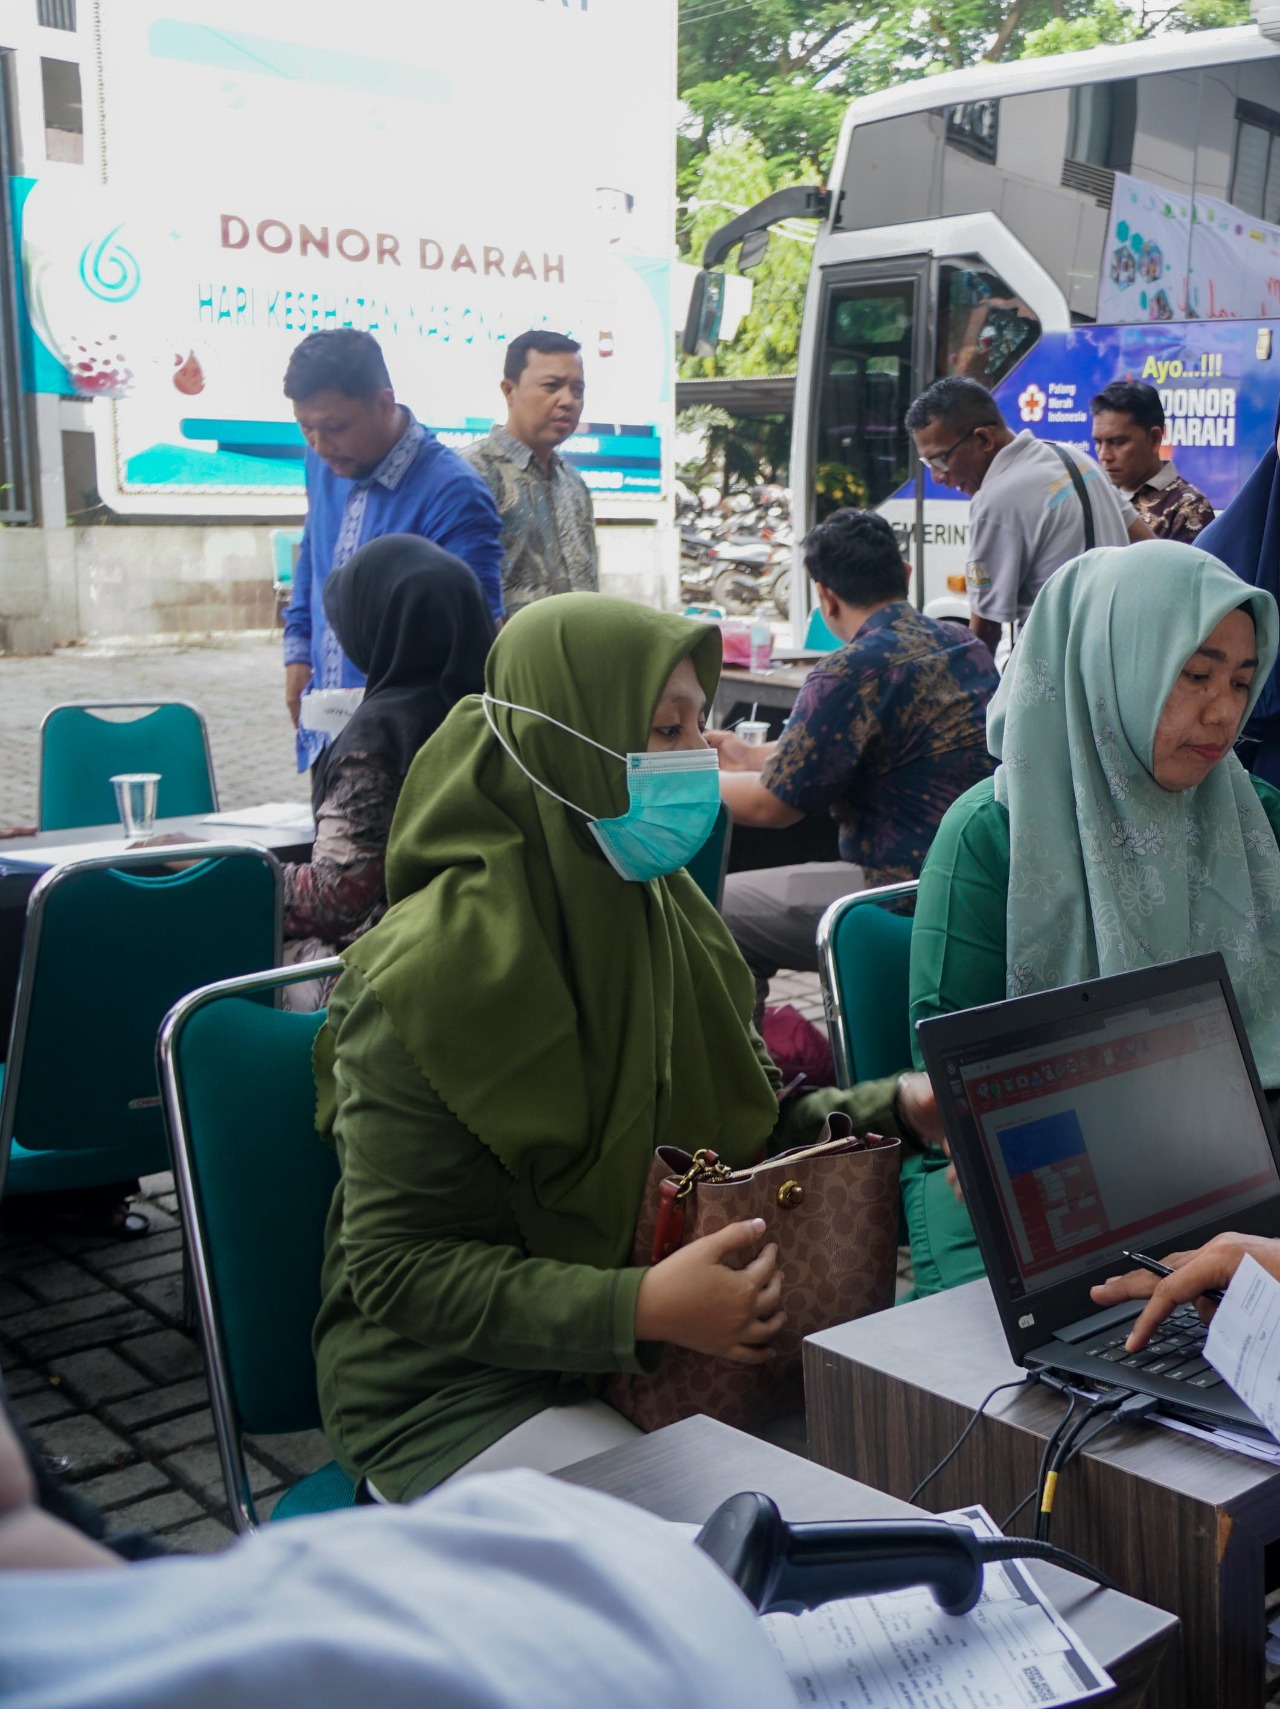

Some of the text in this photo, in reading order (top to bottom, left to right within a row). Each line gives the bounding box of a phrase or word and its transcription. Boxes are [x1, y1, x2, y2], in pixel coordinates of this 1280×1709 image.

[220, 213, 566, 284] DONOR DARAH
[198, 283, 256, 326] HARI
[1048, 383, 1077, 396] Palang
[1160, 387, 1236, 418] DONOR
[1047, 410, 1088, 423] Indonesia
[1161, 417, 1236, 448] DARAH
